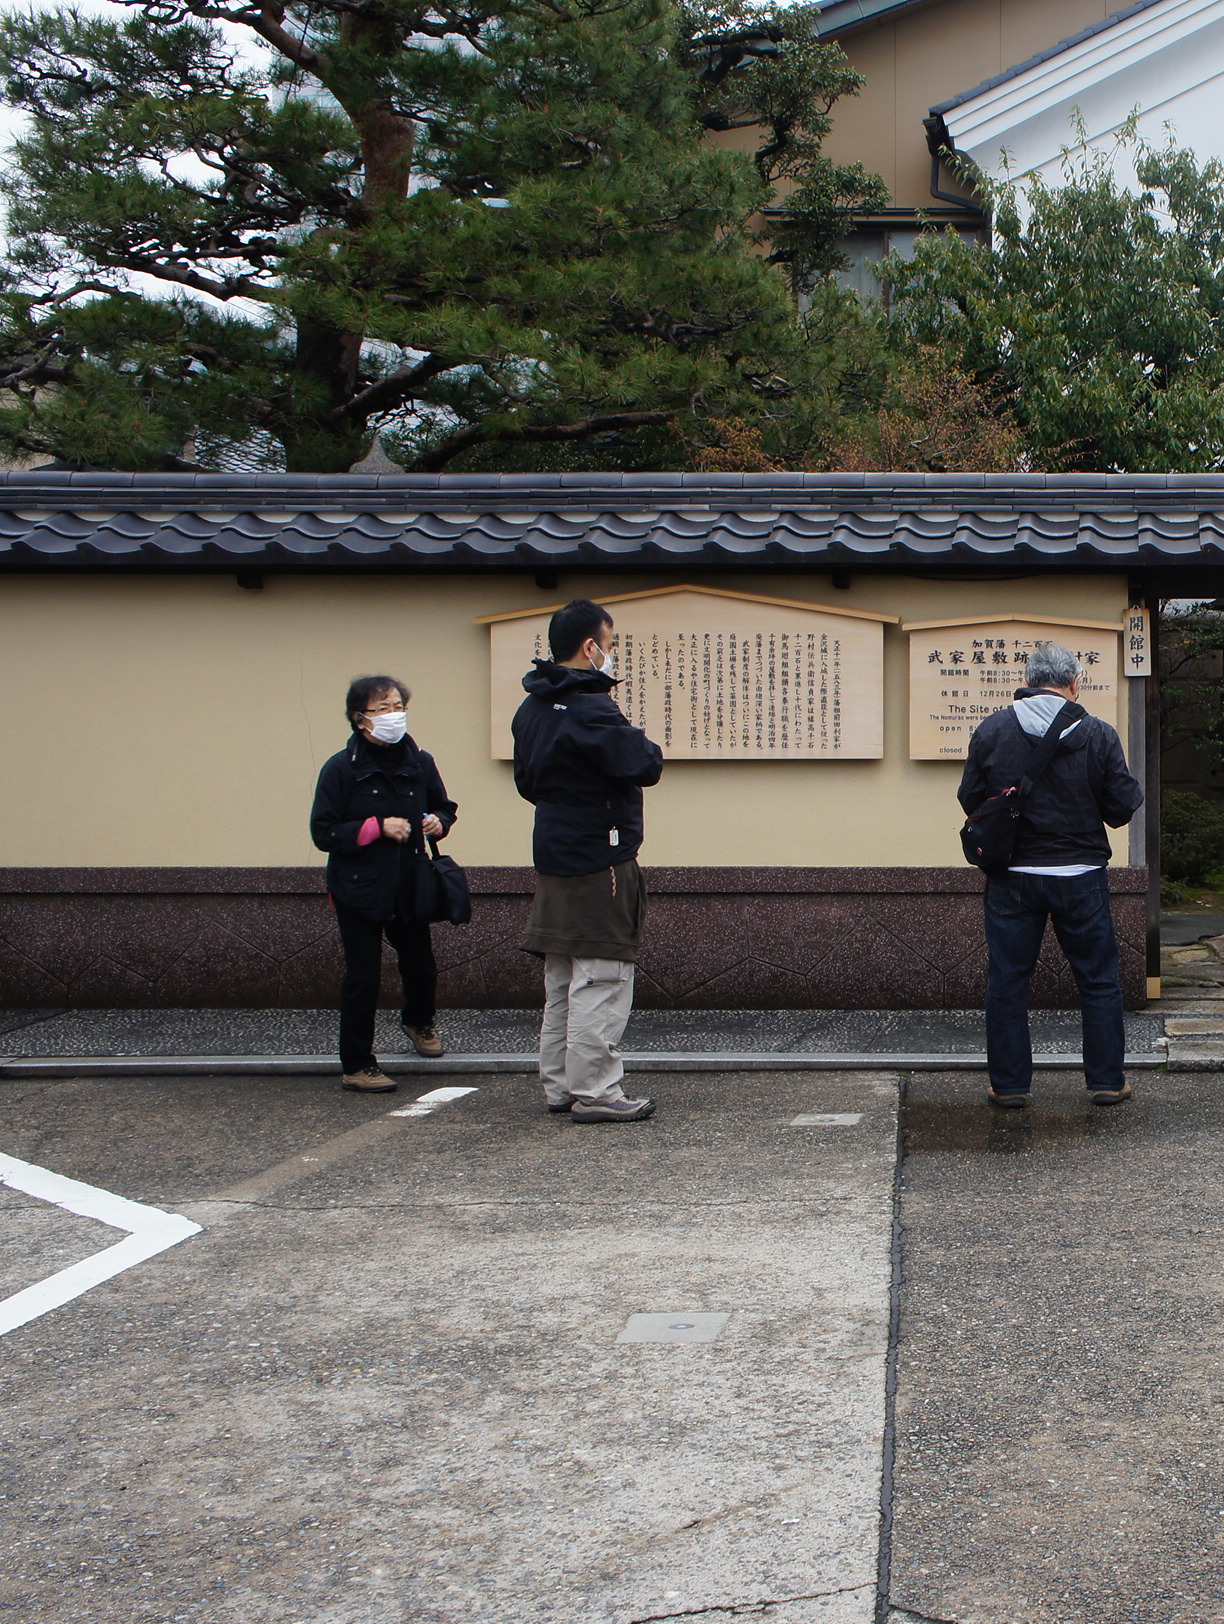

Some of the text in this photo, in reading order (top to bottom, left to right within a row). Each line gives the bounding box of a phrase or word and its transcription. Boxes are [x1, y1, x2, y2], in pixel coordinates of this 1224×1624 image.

[534, 633, 542, 660] 文化を
[651, 633, 660, 679] とどめている。
[928, 650, 1030, 665] 武家屋敷跡
[972, 639, 1006, 649] 加賀藩
[1129, 615, 1145, 670] 開館中
[677, 633, 686, 690] 至ったのである。
[638, 642, 646, 732] いくたびか住人をかえたが
[948, 705, 967, 714] The
[969, 705, 990, 714] Site
[992, 705, 1003, 714] of
